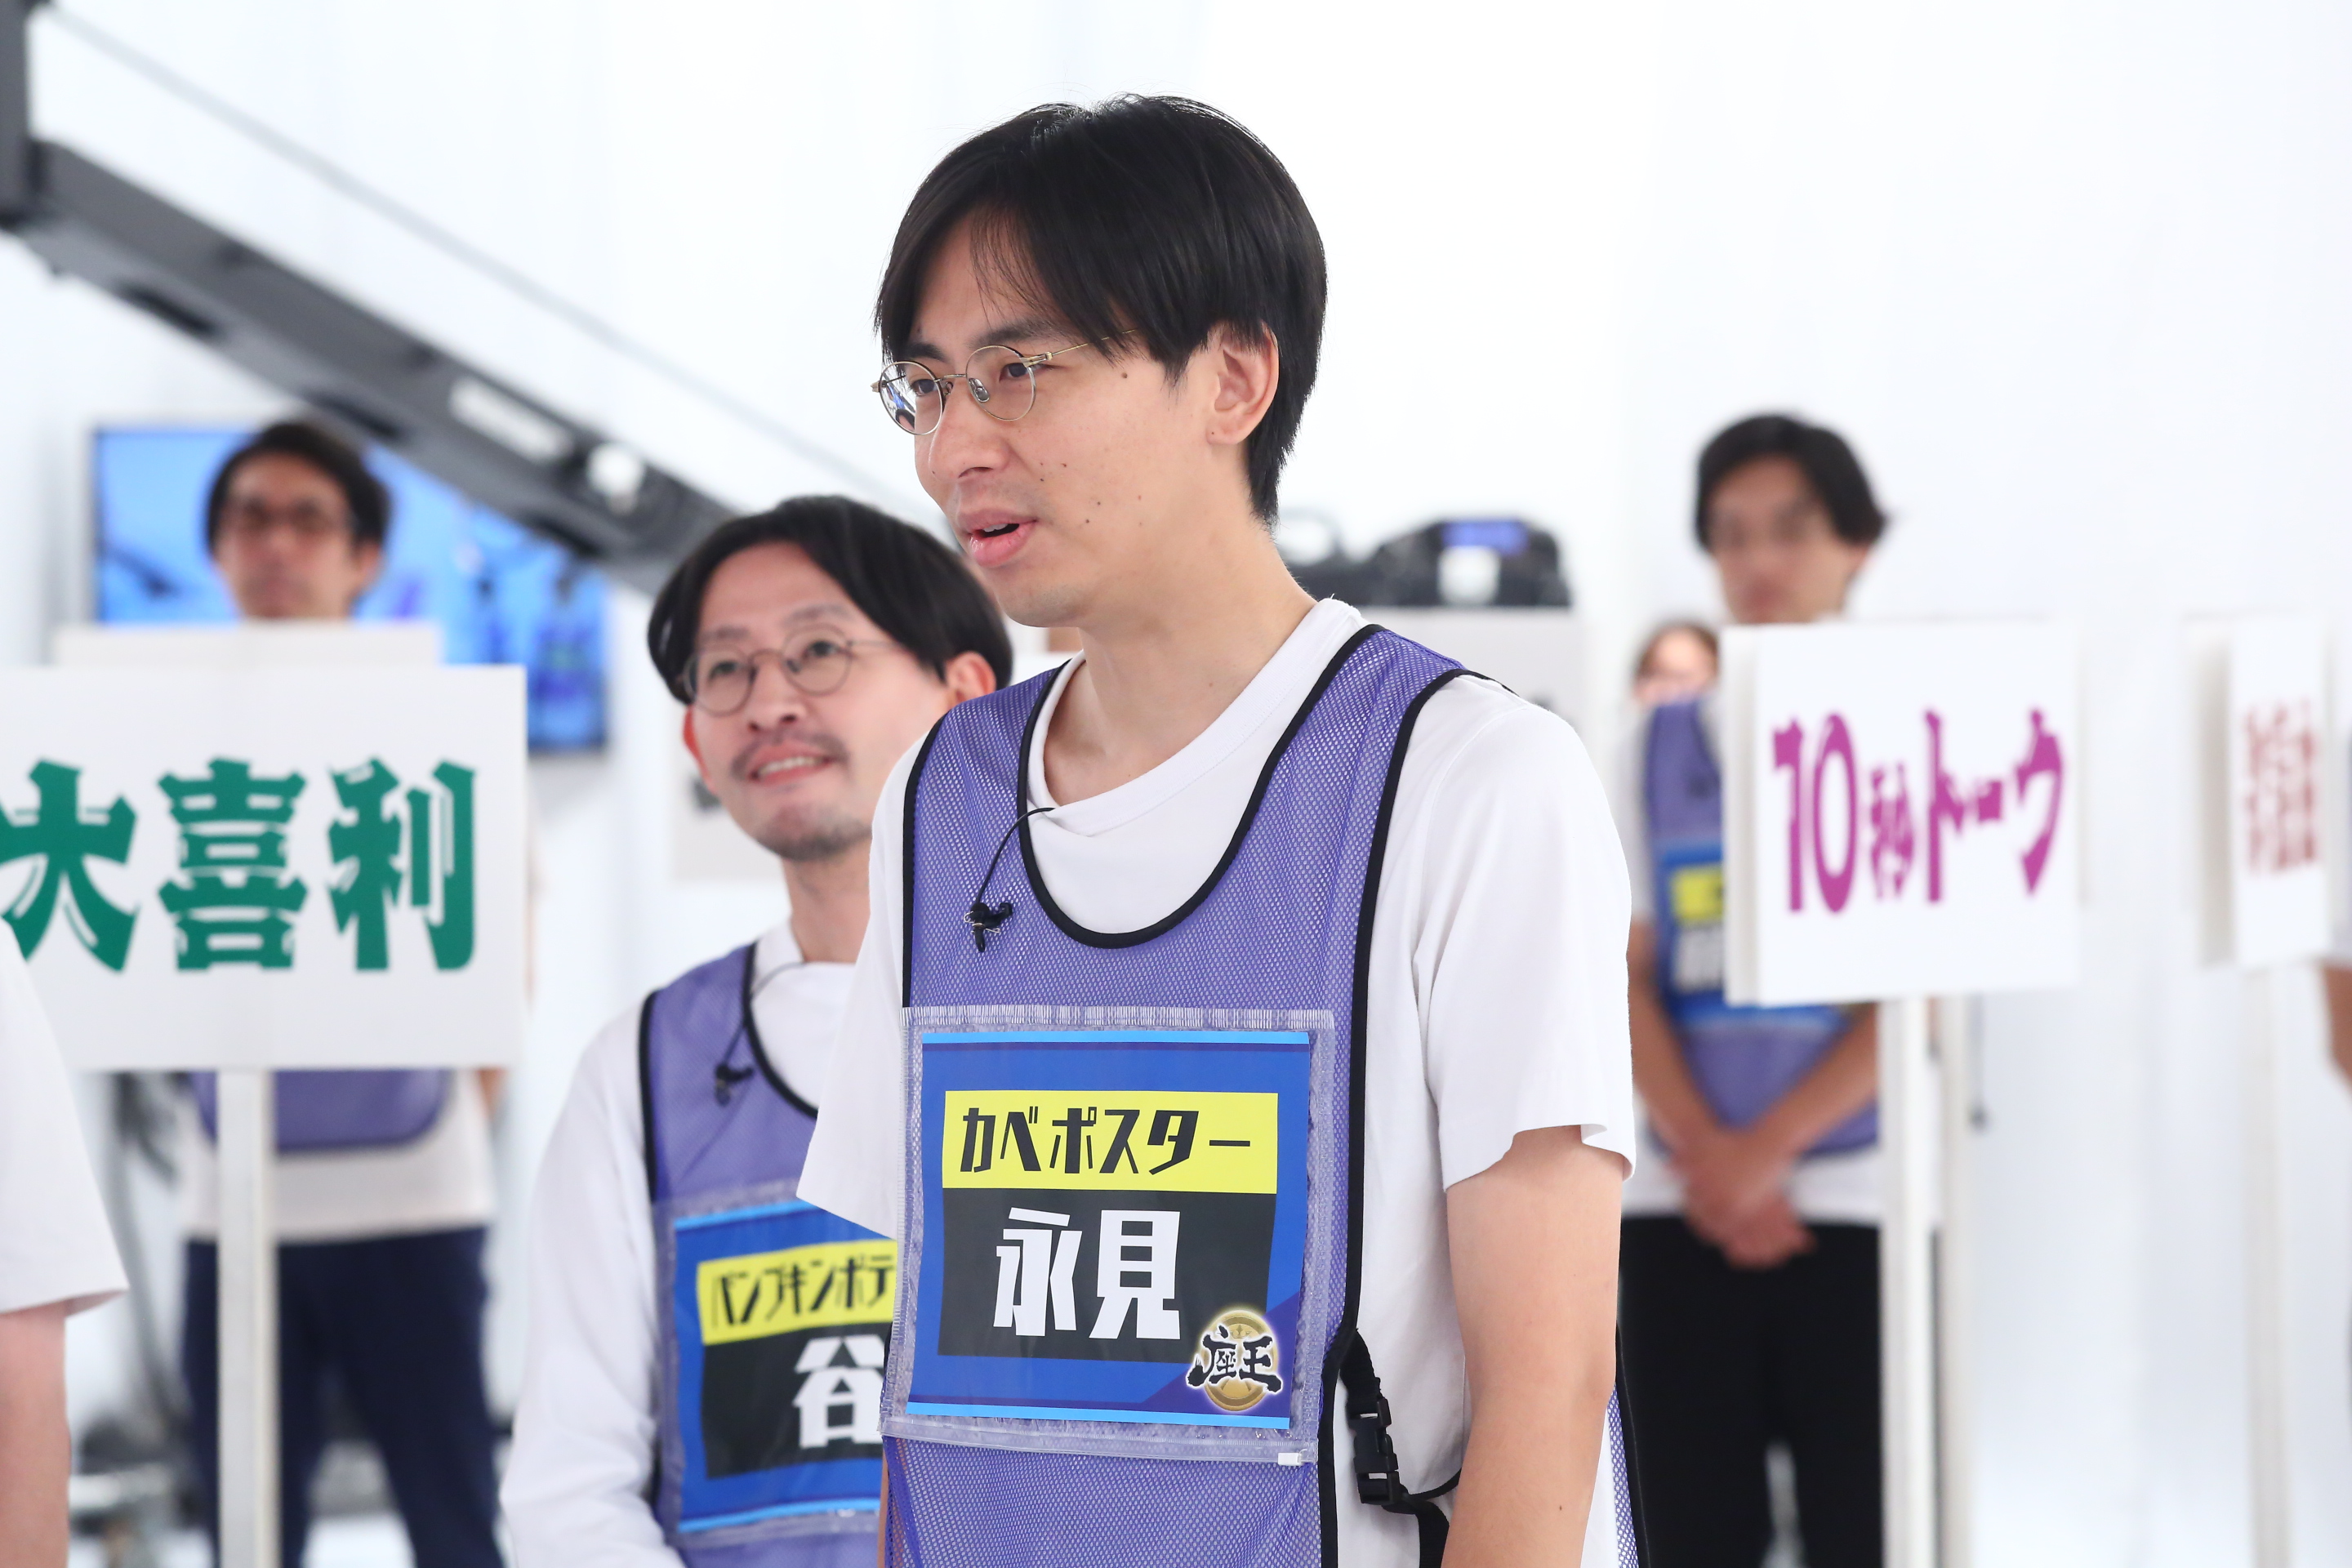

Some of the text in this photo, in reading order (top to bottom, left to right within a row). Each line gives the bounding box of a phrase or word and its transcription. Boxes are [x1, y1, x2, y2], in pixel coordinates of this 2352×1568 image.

[0, 756, 477, 973] 大喜利
[1774, 709, 2063, 913] 10秒トーク
[960, 1106, 1251, 1175] カベポスター
[993, 1207, 1181, 1339] 永見
[792, 1334, 884, 1449] 谷
[1187, 1325, 1282, 1393] 座王
